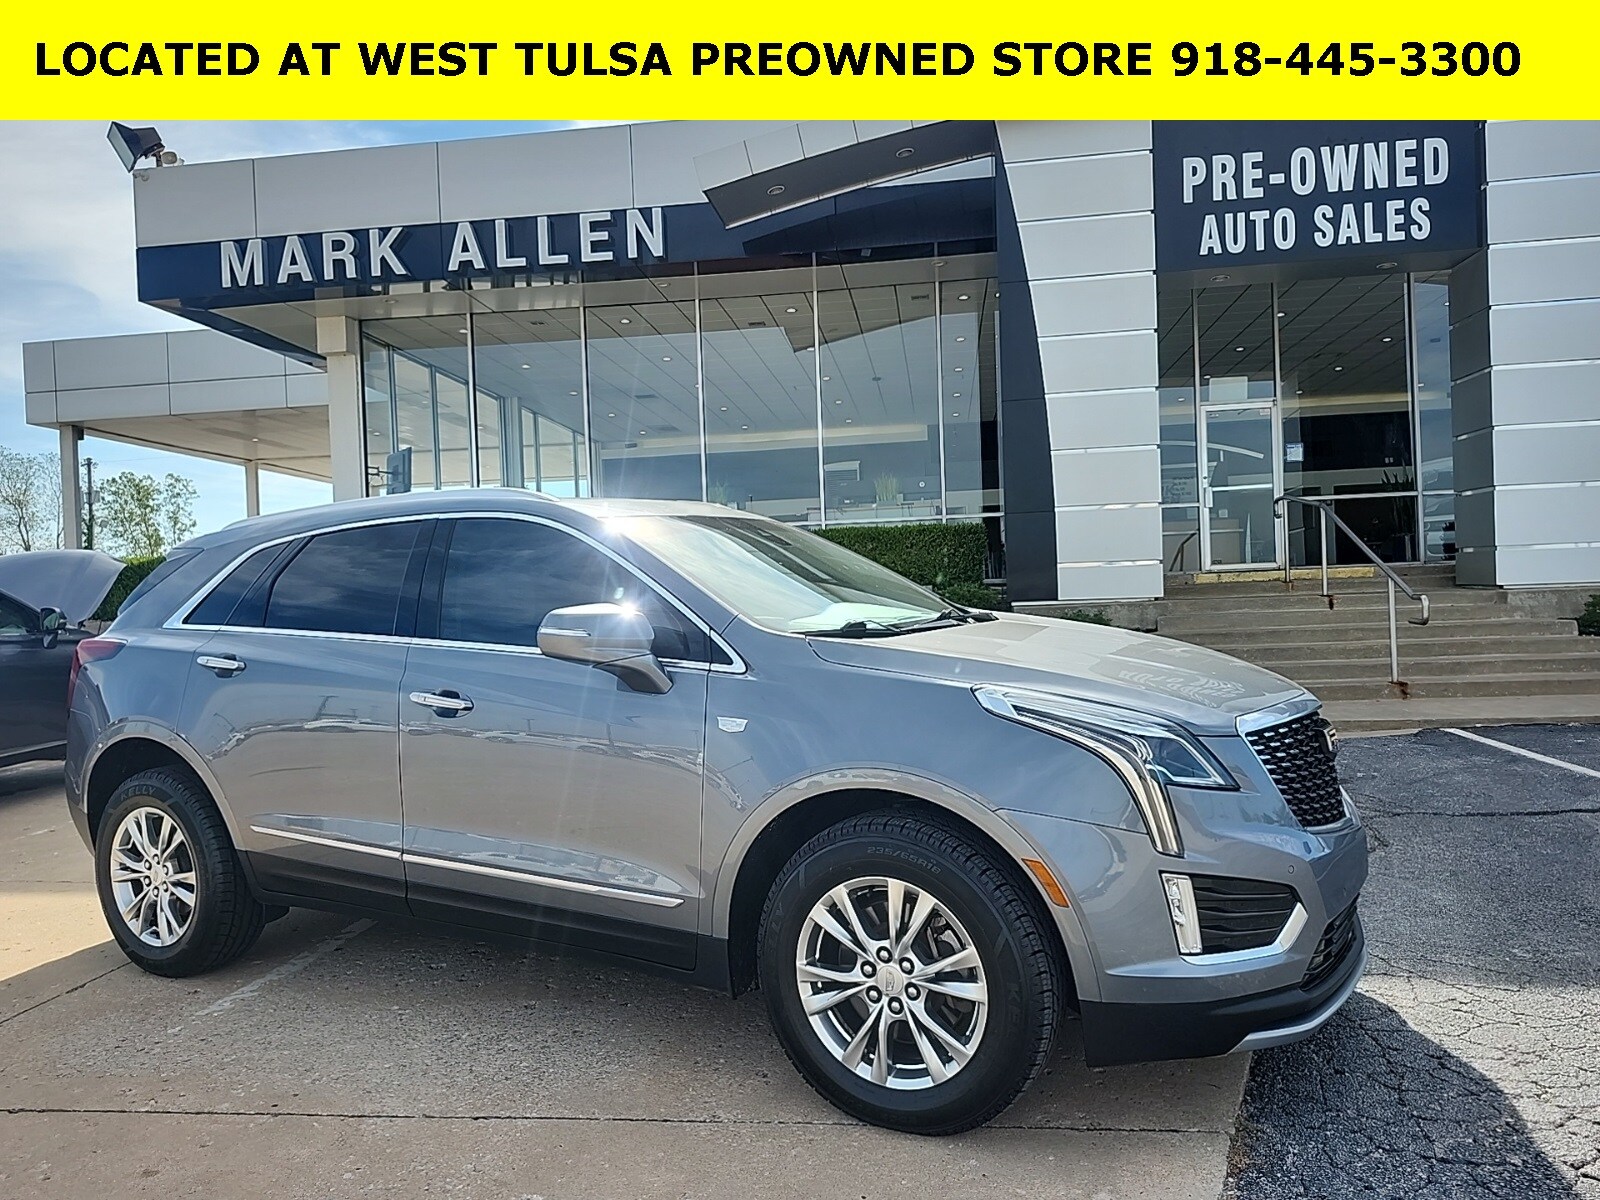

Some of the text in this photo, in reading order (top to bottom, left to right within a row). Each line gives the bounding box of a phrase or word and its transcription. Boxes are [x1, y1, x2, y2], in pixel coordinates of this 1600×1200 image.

[1182, 137, 1449, 204] PRE-OWNED
[220, 207, 664, 288] MARK ALLEN
[1199, 197, 1431, 256] AUTO SALES
